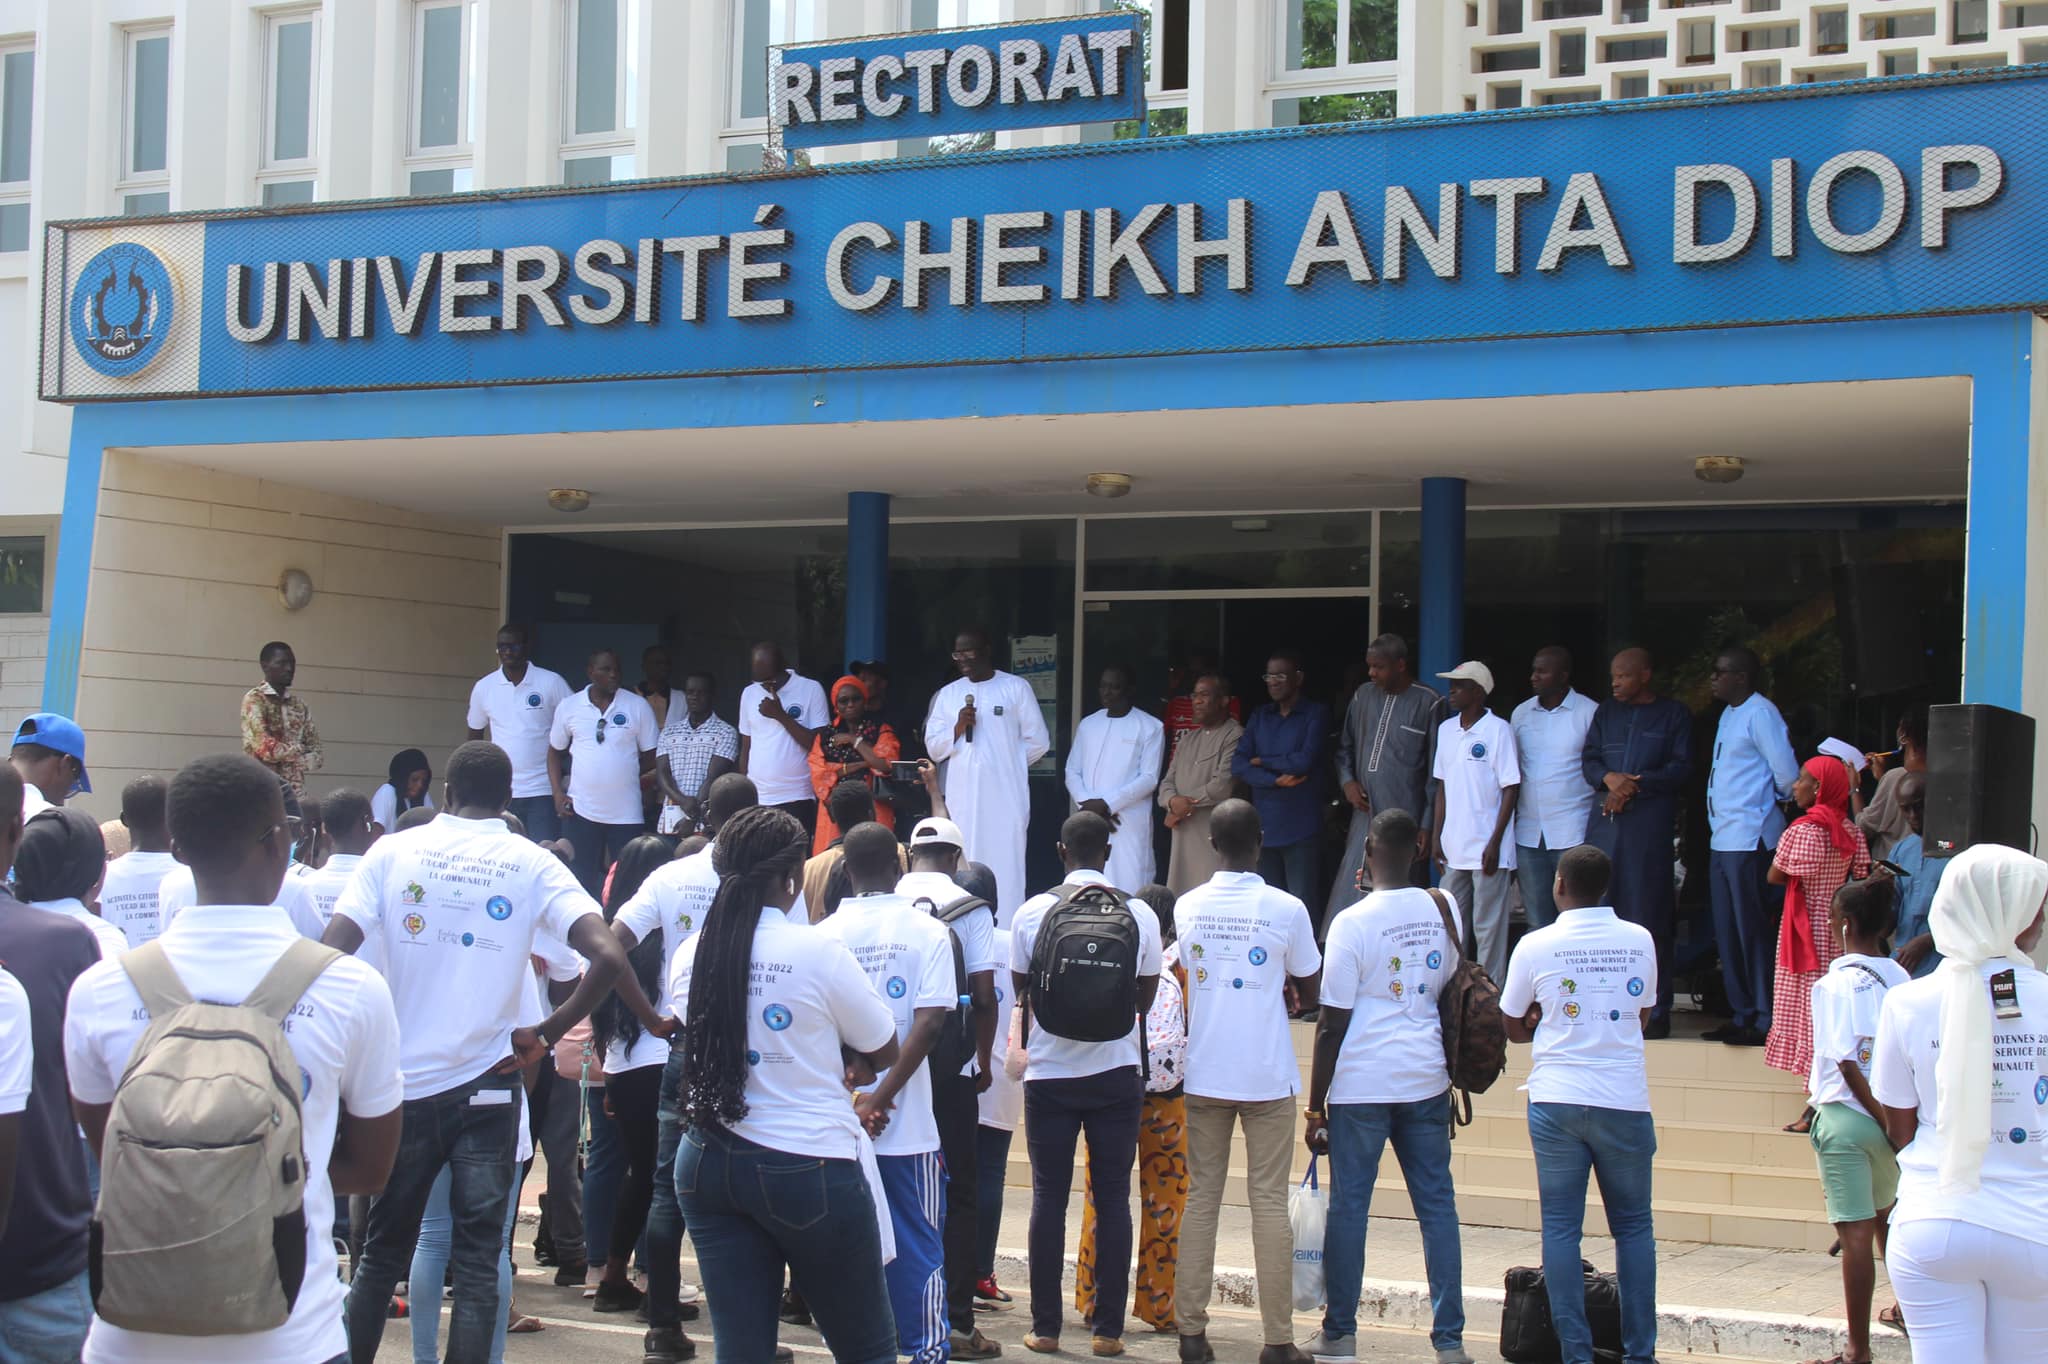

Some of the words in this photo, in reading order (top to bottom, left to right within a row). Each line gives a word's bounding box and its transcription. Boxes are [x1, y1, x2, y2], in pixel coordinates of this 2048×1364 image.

[775, 29, 1135, 126] RECTORAT
[225, 204, 788, 344] UNIVERSITÉ
[825, 198, 1248, 311] CHEIKH
[1285, 172, 1631, 287] ANTA
[1672, 144, 2005, 264] DIOP
[500, 862, 521, 873] 2022
[429, 871, 438, 879] LA
[495, 869, 507, 879] DE
[1254, 918, 1271, 927] 2022
[1601, 956, 1626, 964] SERVICE
[768, 962, 793, 974] 2022
[765, 974, 777, 983] DE
[1995, 1046, 2033, 1057] SERVICE
[2036, 1046, 2048, 1056] DE
